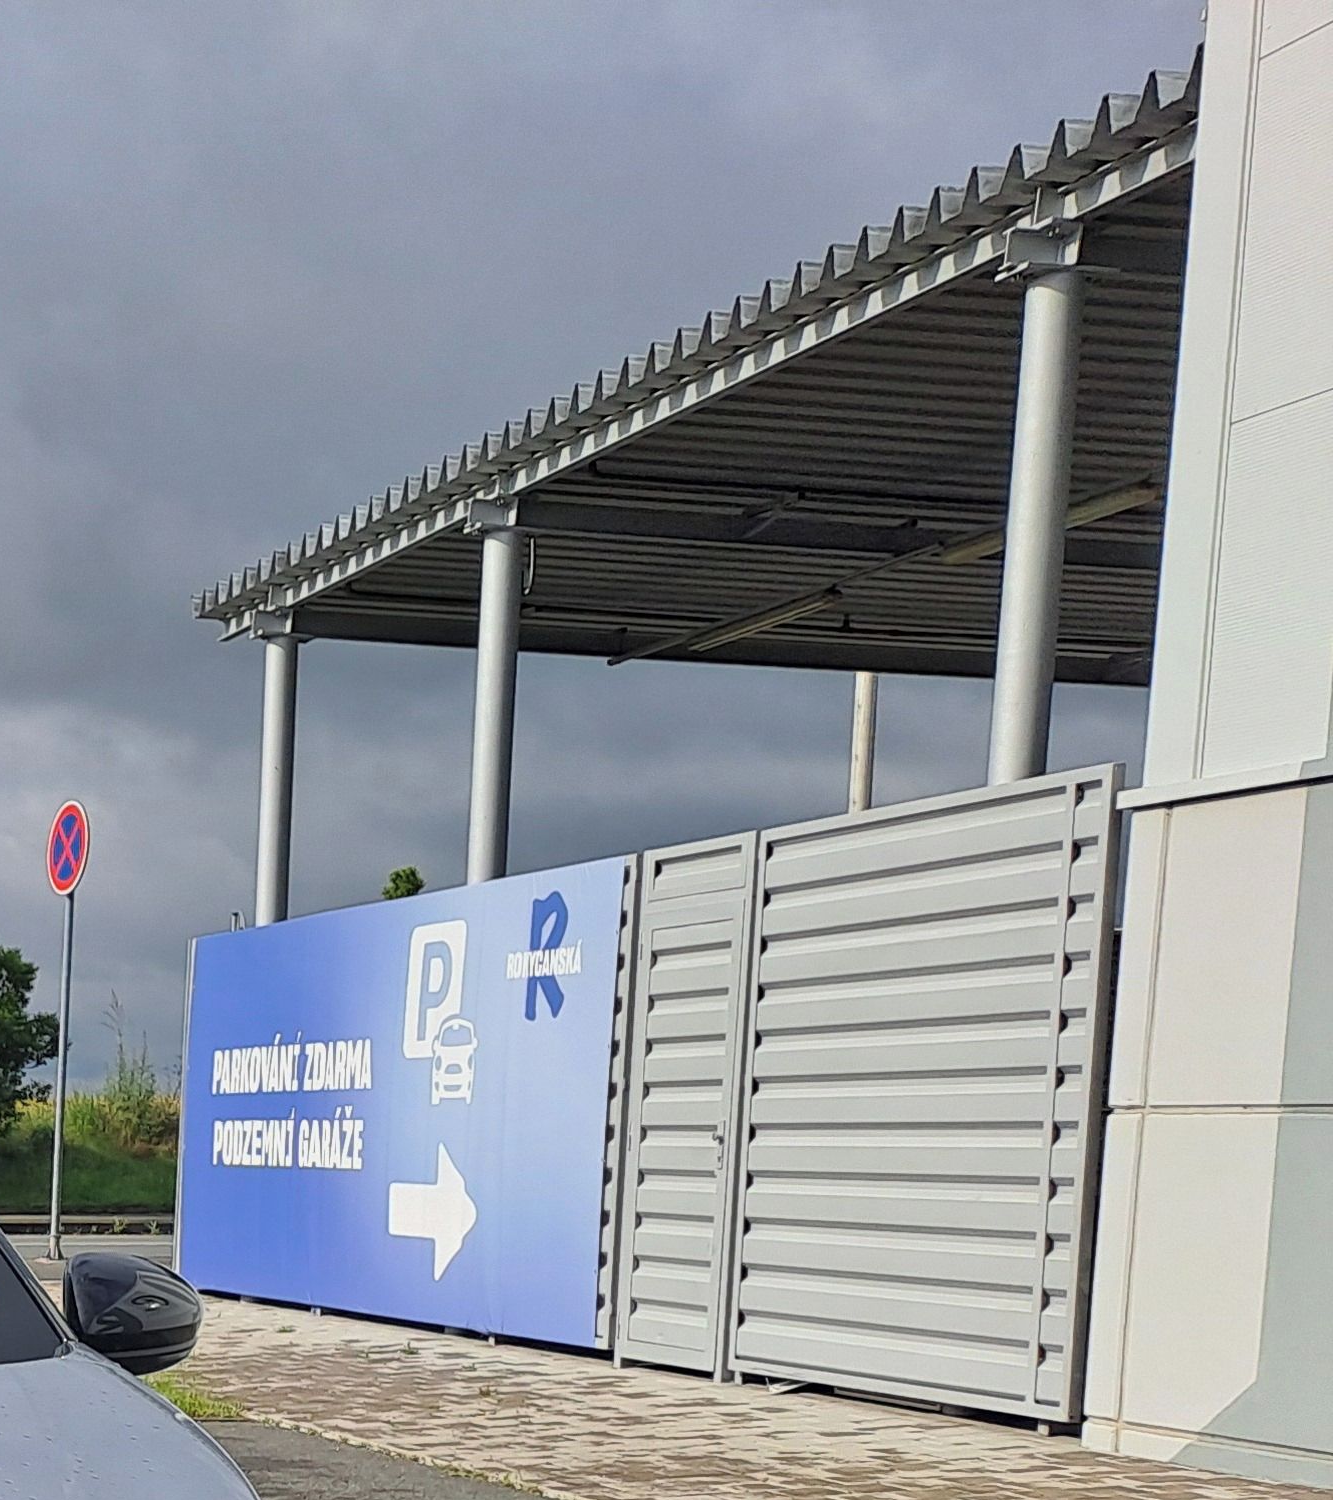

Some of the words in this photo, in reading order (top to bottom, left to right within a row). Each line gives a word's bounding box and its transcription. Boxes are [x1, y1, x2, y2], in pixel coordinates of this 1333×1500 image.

[506, 939, 582, 979] ROKYCANSKÁ
[418, 940, 453, 1042] P
[211, 1032, 301, 1094] PARKOVÁNÍ
[302, 1038, 373, 1092] ZDARMA
[212, 1107, 296, 1167] PODZEMNÍ
[298, 1105, 364, 1170] GARÁŽE
